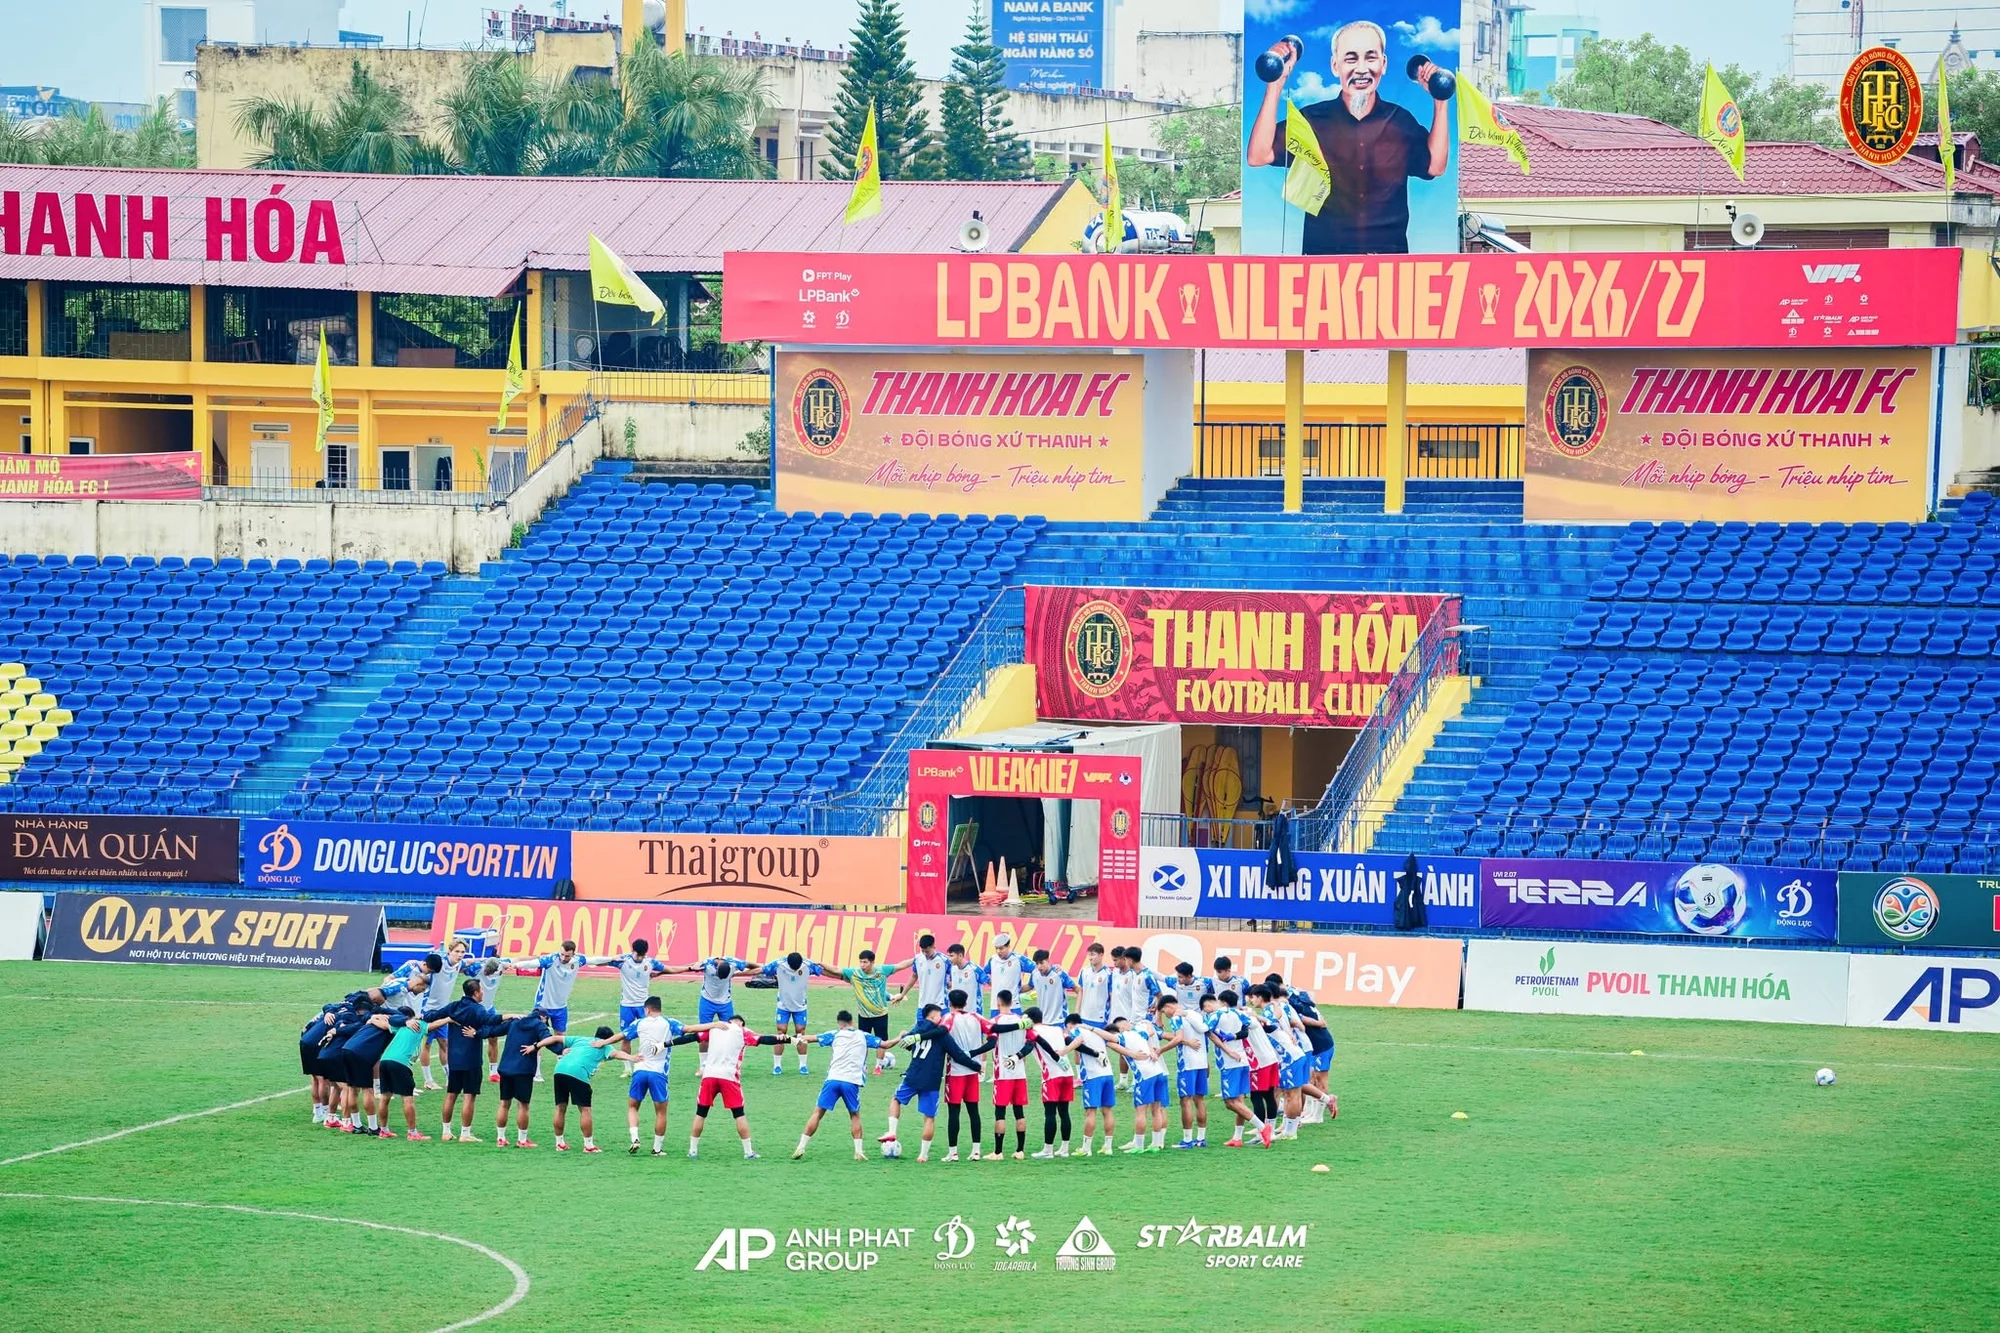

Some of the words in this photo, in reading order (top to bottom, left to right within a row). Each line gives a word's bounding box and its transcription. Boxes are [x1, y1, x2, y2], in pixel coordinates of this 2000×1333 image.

[1053, 2, 1093, 12] BANK
[1009, 32, 1025, 44] HỆ
[1028, 33, 1056, 43] SINH
[1060, 31, 1088, 43] THÁI
[1003, 46, 1037, 58] NGÂN
[1041, 46, 1075, 58] HÀNG
[205, 183, 346, 265] HÓA
[816, 271, 832, 281] FPT
[834, 271, 852, 282] Play
[799, 288, 851, 303] LPBank
[936, 261, 1170, 340] LPBANK
[1514, 259, 1706, 338] 2026/27
[859, 371, 1001, 417] THANH
[987, 373, 1085, 418] HOA
[1618, 367, 1768, 415] THANH
[1757, 367, 1865, 415] HOA
[901, 429, 935, 450] ĐỘI
[938, 430, 992, 448] BÓNG
[996, 430, 1023, 448] XỨ
[1025, 434, 1092, 448] THANH
[1661, 429, 1698, 449] ĐỘI
[1701, 429, 1761, 447] BÓNG
[1765, 429, 1795, 447] XỨ
[1798, 432, 1872, 447] THANH
[34, 457, 61, 478] MỘ
[908, 463, 943, 490] nhịp
[947, 463, 988, 493] bóng
[1007, 465, 1050, 485] Triệu
[1052, 464, 1087, 493] nhịp
[1088, 467, 1126, 485] tim
[1620, 459, 1664, 487] Mỗi
[1668, 464, 1705, 491] nhịp
[1709, 463, 1756, 493] bóng
[1778, 464, 1822, 486] Triệu
[1825, 464, 1864, 492] nhịp
[1866, 466, 1909, 485] tim
[43, 477, 76, 495] HÓA
[79, 481, 99, 494] FC
[103, 480, 110, 494] !
[1147, 609, 1304, 670] THANH
[1321, 602, 1420, 673] HÓA
[1176, 679, 1314, 715] FOOTBALL
[917, 767, 957, 778] LPBank
[15, 819, 46, 829] NHÀ
[48, 818, 89, 830] HÀNG
[12, 832, 92, 859] ĐAM
[99, 828, 198, 867] QUÁN
[314, 838, 558, 880] DONGLUCSPORT.VN
[257, 875, 284, 884] ĐỘNG
[1207, 865, 1231, 899] XI
[1319, 865, 1386, 905] XUÂN
[1494, 879, 1647, 907] TERRA
[228, 910, 349, 950] SPORT
[1777, 918, 1797, 927] ĐỘNG
[129, 949, 145, 958] NƠI
[147, 949, 161, 960] HỘI
[163, 951, 174, 962] TỤ
[175, 950, 191, 960] CÁC
[229, 953, 248, 964] HIỆU
[266, 956, 288, 964] THAO
[289, 956, 313, 965] HÀNG
[1313, 951, 1415, 1003] Play
[1515, 976, 1579, 986] PETROVIETNAM
[1587, 971, 1650, 995] PVOIL
[1658, 974, 1736, 998] THANH
[1742, 972, 1791, 1001] HÓA
[1532, 987, 1560, 997] PVOIL
[1882, 967, 2000, 1023] AP
